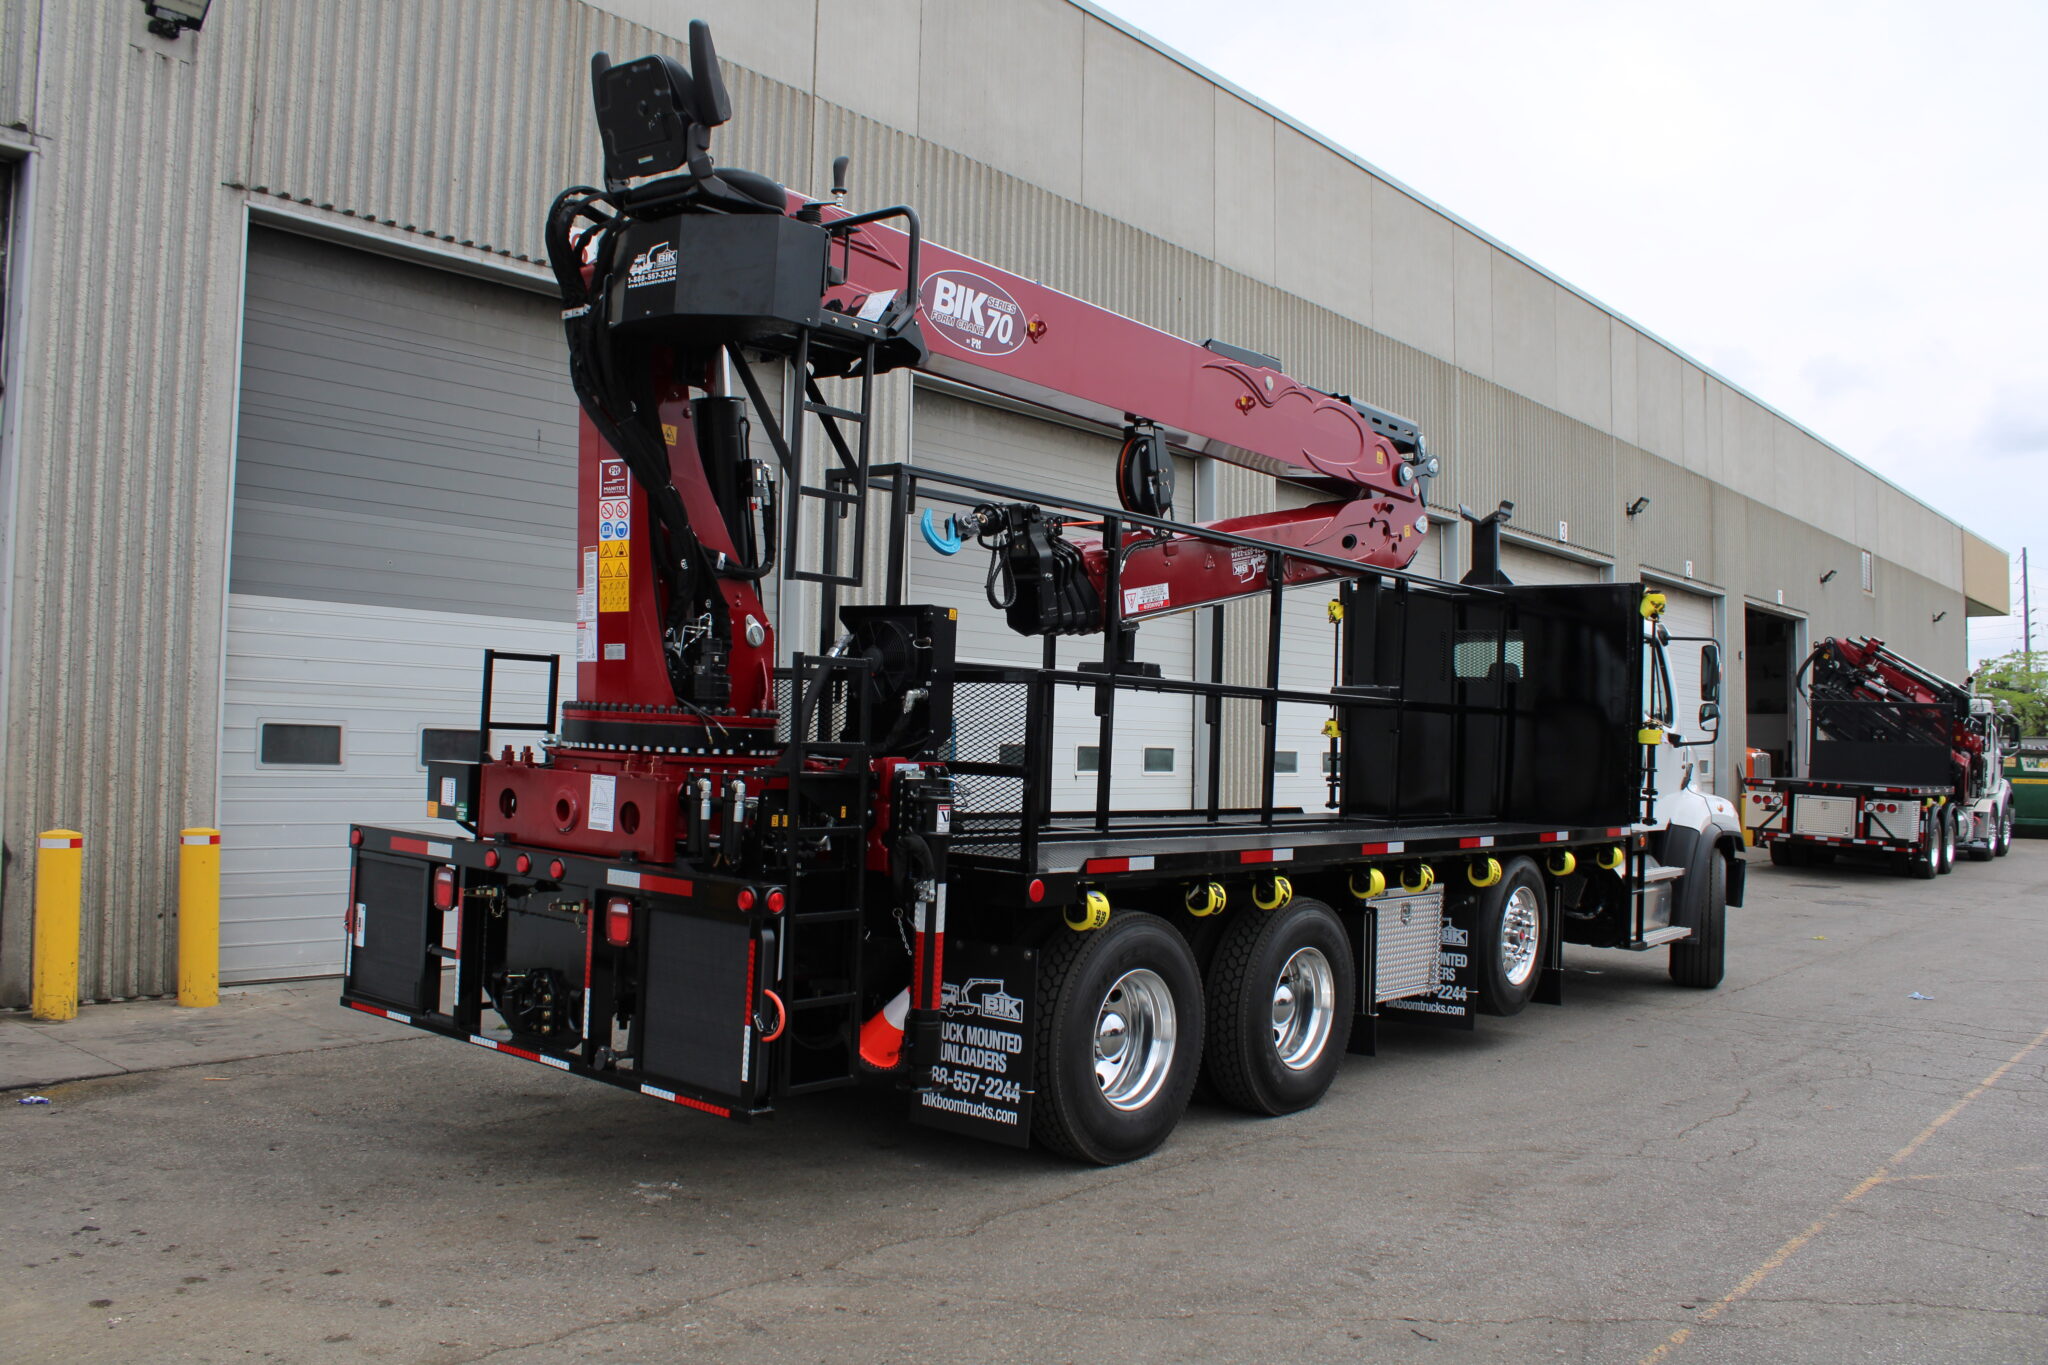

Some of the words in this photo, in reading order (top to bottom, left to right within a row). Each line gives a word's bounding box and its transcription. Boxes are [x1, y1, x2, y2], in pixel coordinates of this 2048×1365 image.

[658, 252, 676, 263] BIK
[933, 277, 988, 327] BIK
[987, 296, 1016, 315] SERIES
[930, 311, 956, 327] FORM
[956, 319, 985, 336] CRANE
[984, 308, 1014, 344] 70
[984, 998, 1020, 1018] BIK
[942, 1021, 964, 1043] UCK
[966, 1025, 1023, 1054] MOUNTED
[941, 1043, 1007, 1073] UNLOADERS
